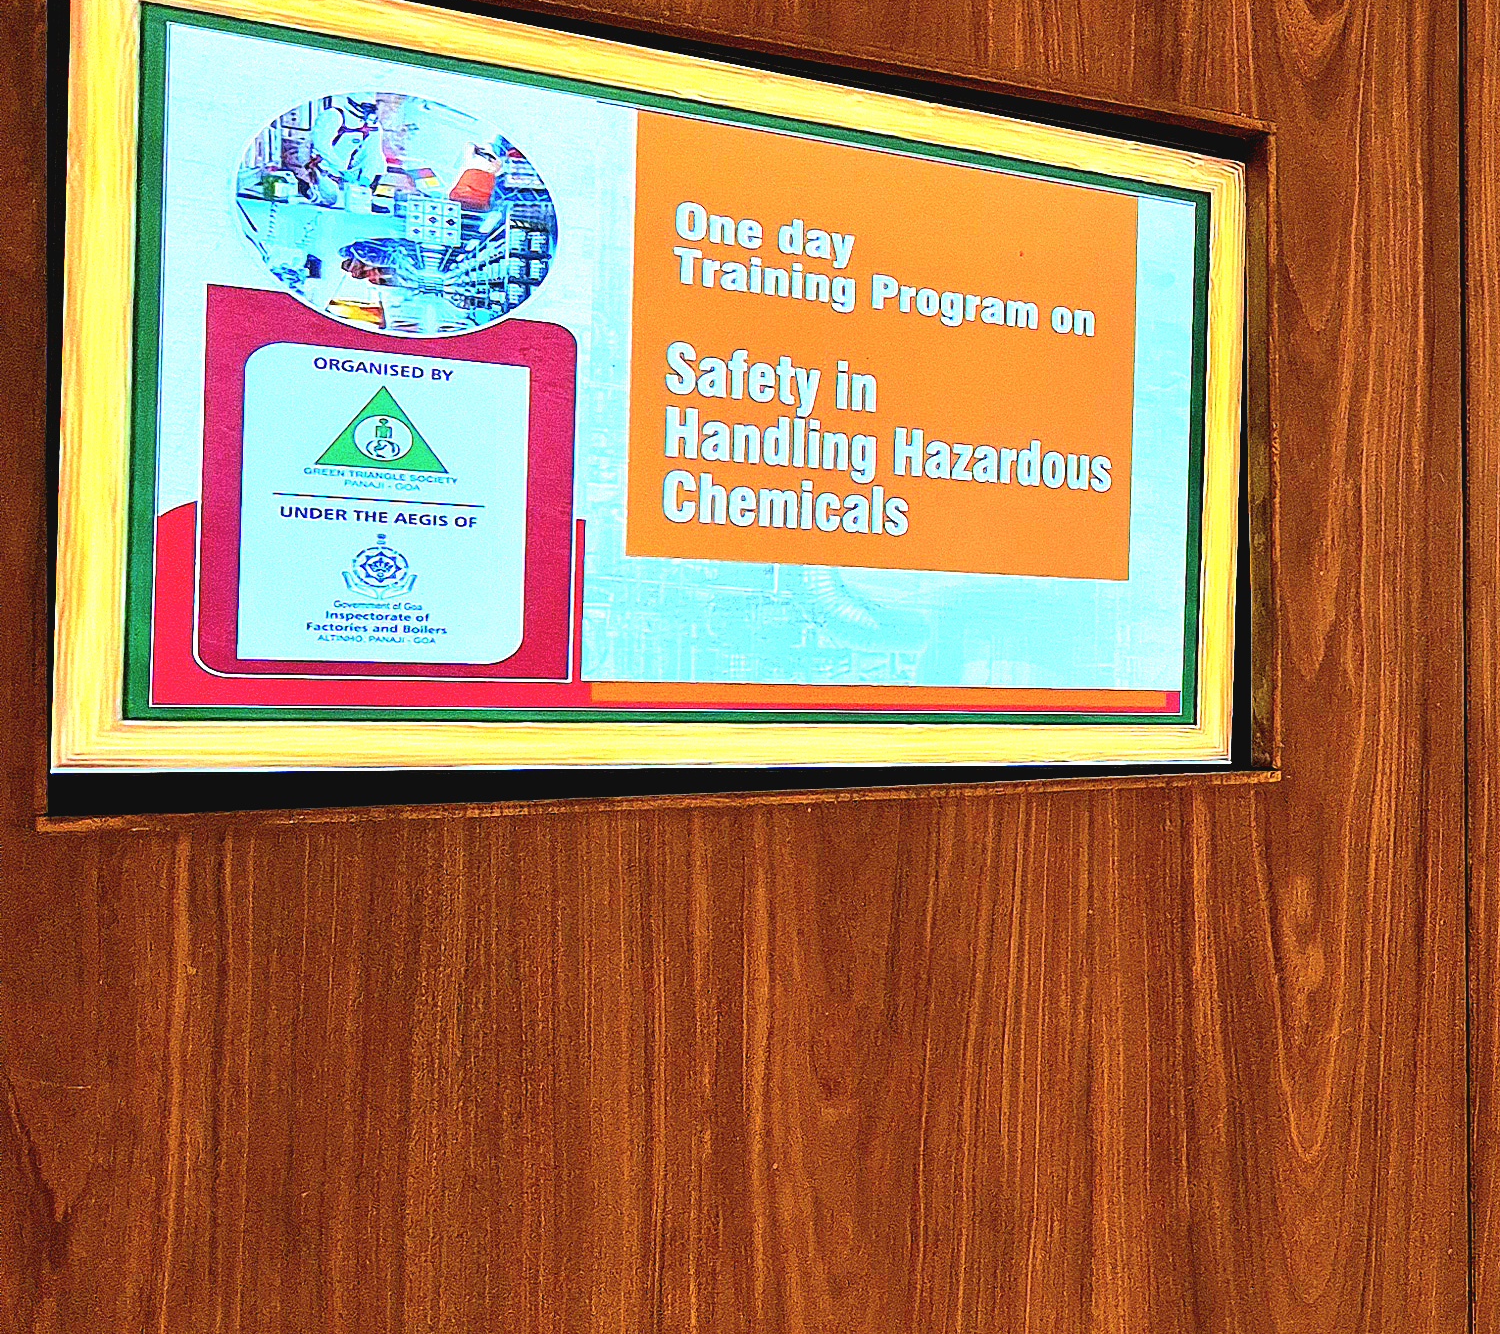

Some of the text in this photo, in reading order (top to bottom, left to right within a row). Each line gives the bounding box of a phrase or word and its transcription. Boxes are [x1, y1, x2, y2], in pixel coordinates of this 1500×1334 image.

[674, 201, 856, 269] One day
[673, 246, 1096, 337] Training Program on
[313, 356, 454, 381] ORGANISED BY
[664, 340, 878, 418] Safety in
[664, 405, 1114, 493] Handling Hazardous
[303, 467, 458, 485] GREEN TRIANGLE SOCIETY
[344, 479, 385, 489] PANAJI
[395, 483, 420, 491] GOA
[661, 469, 910, 537] Chemicals
[279, 505, 478, 528] UNDER THE AEGIS OF
[325, 610, 430, 622] Inspectorate of
[403, 602, 423, 611] Goa
[306, 621, 448, 634] Factories and Boilers
[413, 636, 436, 644] GOA
